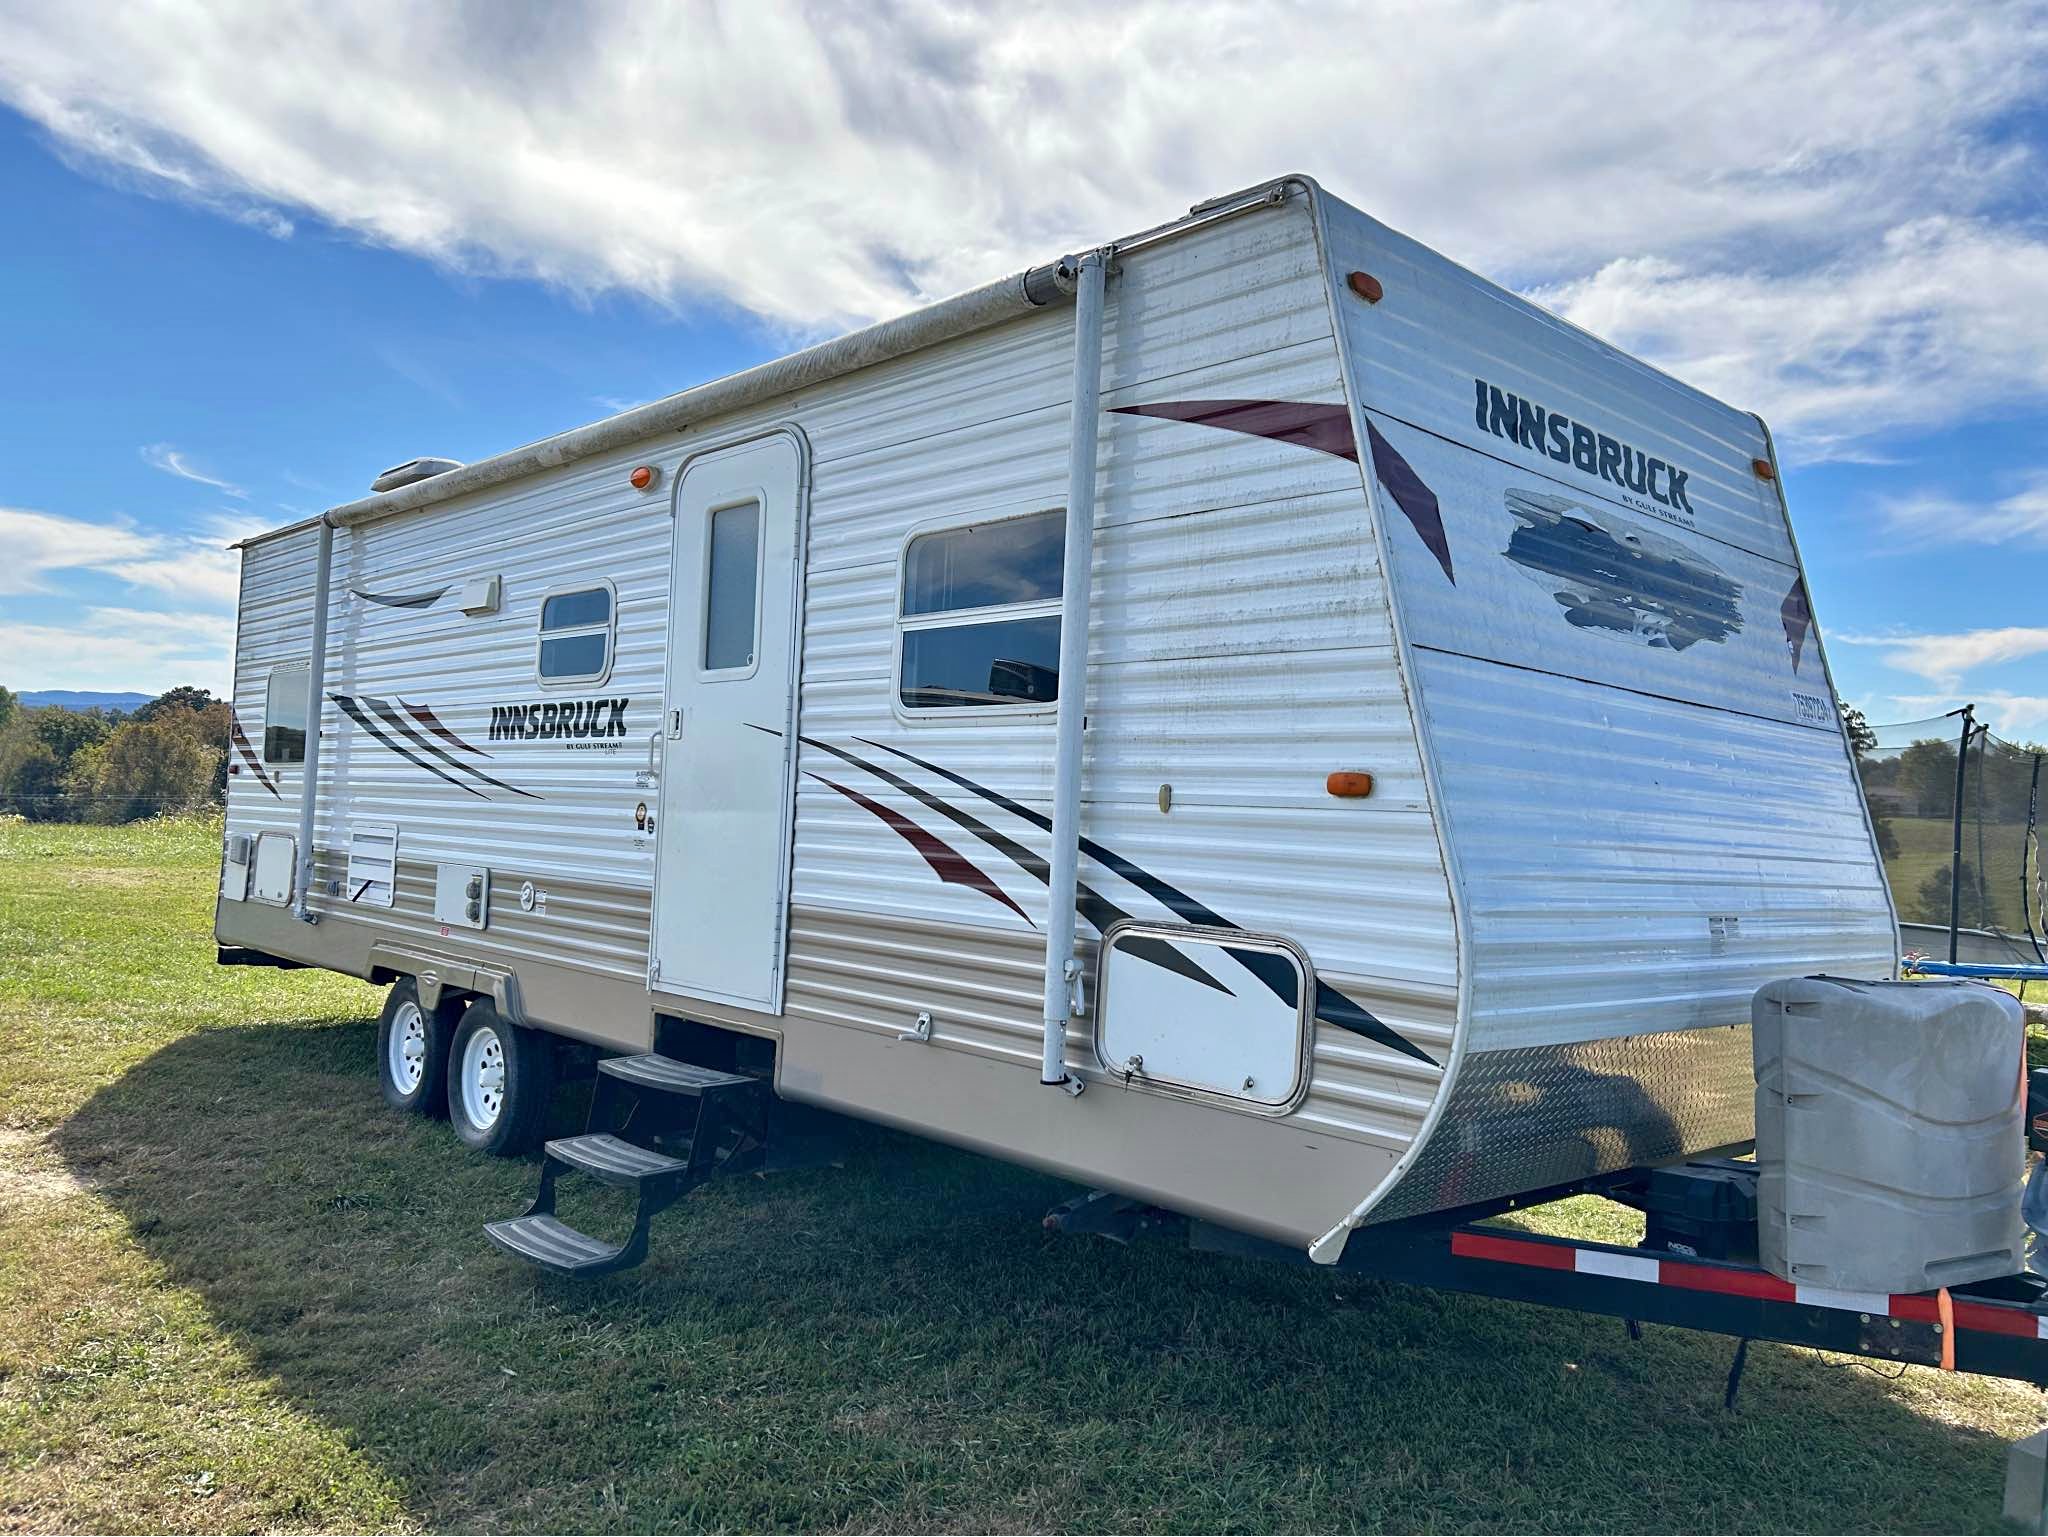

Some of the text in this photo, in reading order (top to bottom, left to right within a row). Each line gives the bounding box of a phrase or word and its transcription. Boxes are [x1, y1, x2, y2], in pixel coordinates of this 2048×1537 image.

[1475, 378, 1695, 515] INNSBRUCK
[1622, 494, 1633, 505] BY
[1635, 500, 1657, 513] GULF
[488, 698, 629, 741] INNSBRUCK
